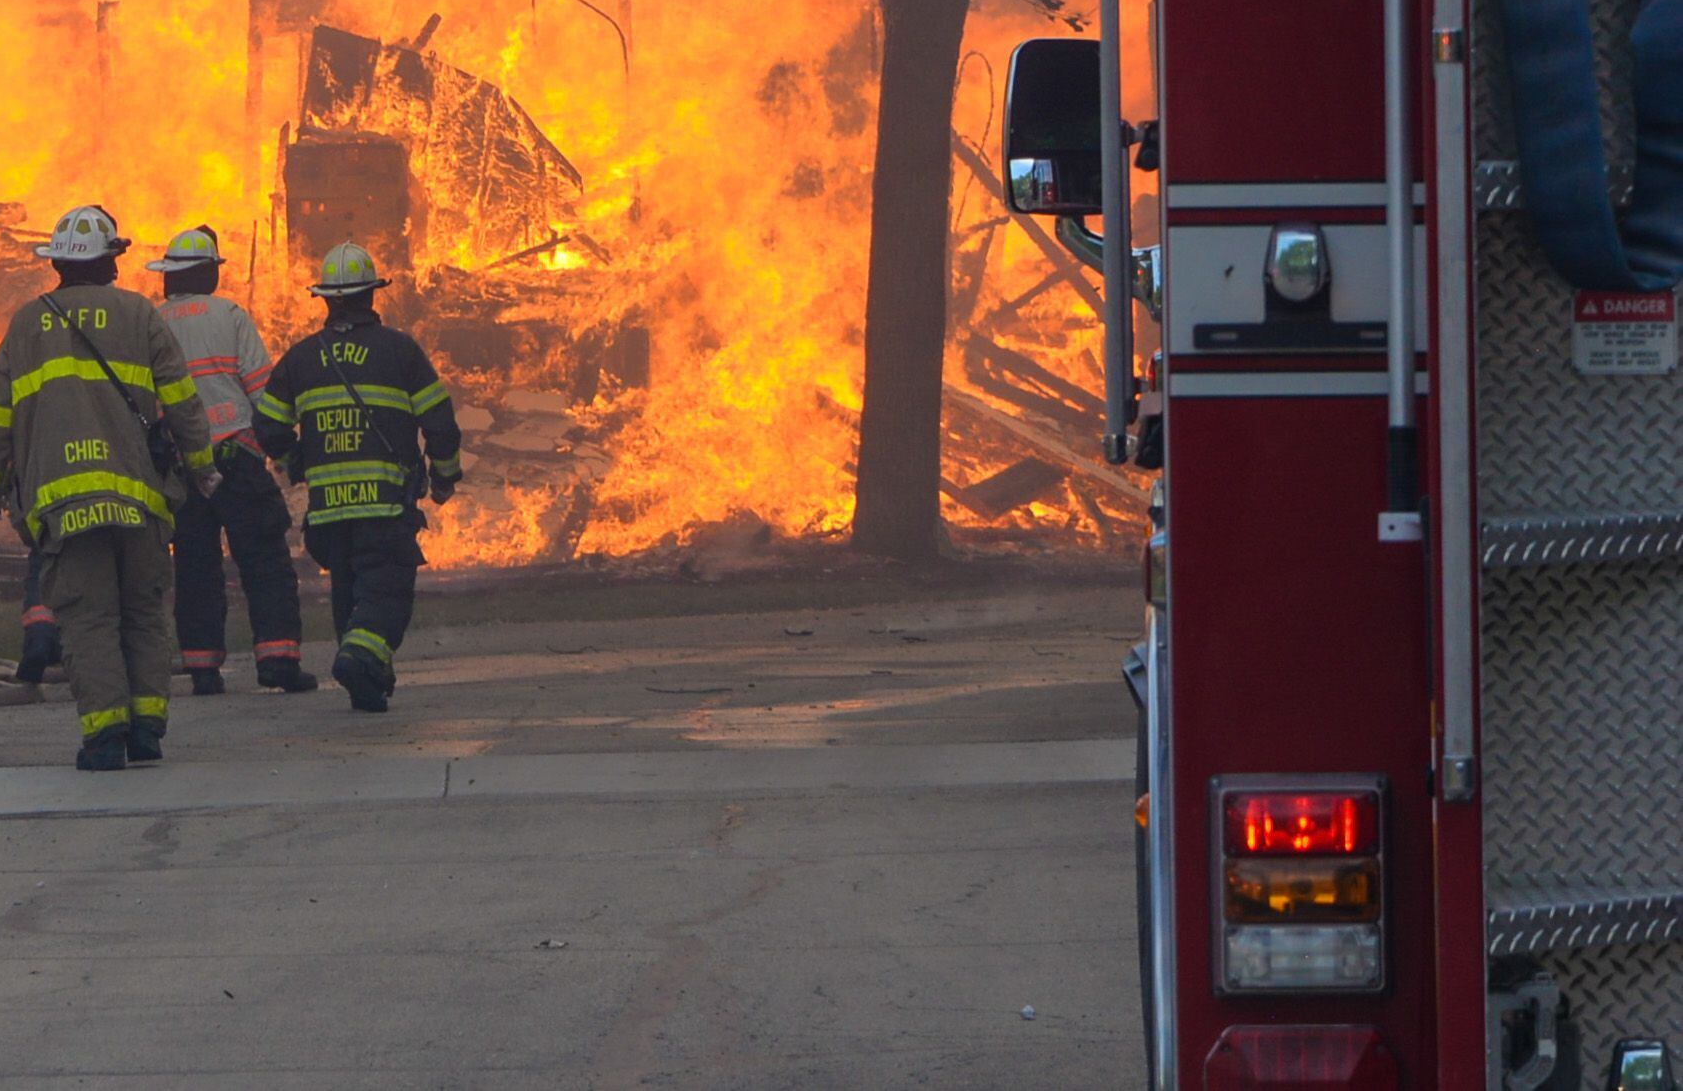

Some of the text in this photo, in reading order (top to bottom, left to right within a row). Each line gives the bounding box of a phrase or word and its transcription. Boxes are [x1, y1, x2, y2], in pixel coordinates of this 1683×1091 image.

[1603, 299, 1667, 314] DANGER
[65, 439, 110, 464] CHIEF
[324, 430, 364, 454] CHIEF
[324, 482, 378, 507] DUNCAN
